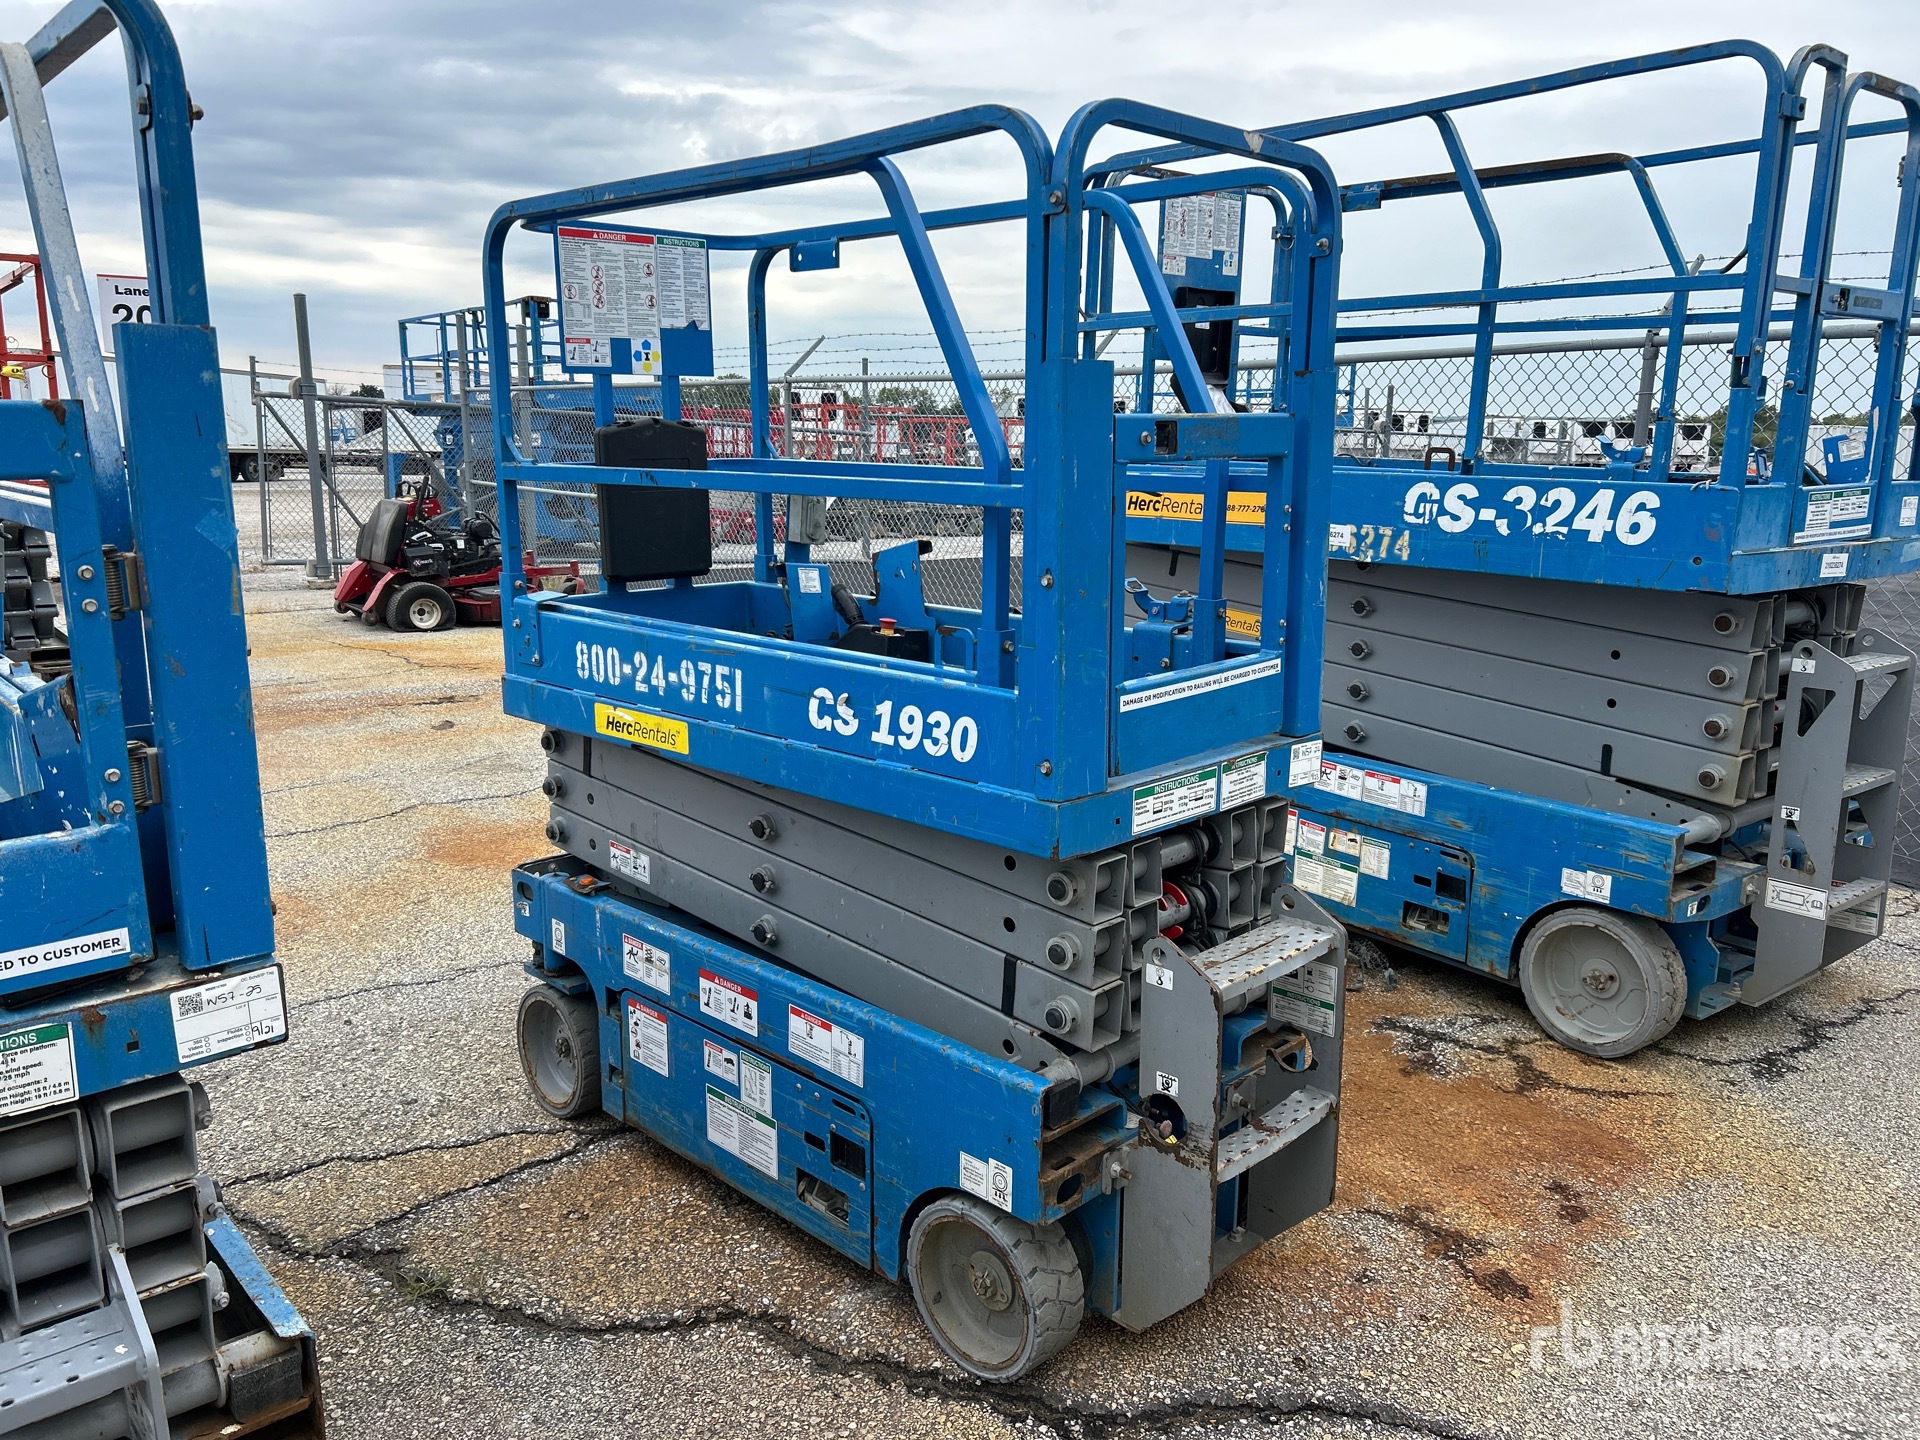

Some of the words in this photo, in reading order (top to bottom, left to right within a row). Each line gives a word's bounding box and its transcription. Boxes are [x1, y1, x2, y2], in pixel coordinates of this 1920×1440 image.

[599, 232, 627, 241] DANGER
[663, 238, 700, 248] INSTRUCTIONS
[114, 284, 150, 297] Lane
[1127, 495, 1203, 515] HercRenta
[1402, 481, 1661, 546] GS-3246
[575, 640, 743, 713] 800-24-9751
[1122, 696, 1144, 707] DAMAGE
[1152, 687, 1186, 700] MODIFICATION
[1186, 685, 1193, 693] TO
[1194, 680, 1212, 690] RAILING
[1212, 677, 1223, 685] WILL
[1231, 670, 1250, 680] CHARGED
[1257, 662, 1279, 674] CUSTOMER
[808, 687, 859, 736] GS
[870, 700, 979, 763] 1930
[1154, 775, 1200, 794] INSTRUCTIONS
[18, 954, 39, 966] TO
[43, 937, 121, 962] CUSTOMER
[720, 979, 742, 993] DANGER
[640, 1006, 658, 1019] DANGER
[805, 1014, 822, 1027] DANGER
[217, 1032, 244, 1044] Inspection
[29, 1042, 58, 1053] platform:
[188, 1043, 203, 1052] Video
[5, 1066, 20, 1075] wind
[22, 1061, 43, 1071] speed:
[14, 1070, 30, 1079] mph
[8, 1079, 43, 1092] occupants:
[9, 1089, 33, 1100] Height:
[10, 1096, 33, 1107] Height:
[724, 1095, 757, 1119] INSTRUCTIONS
